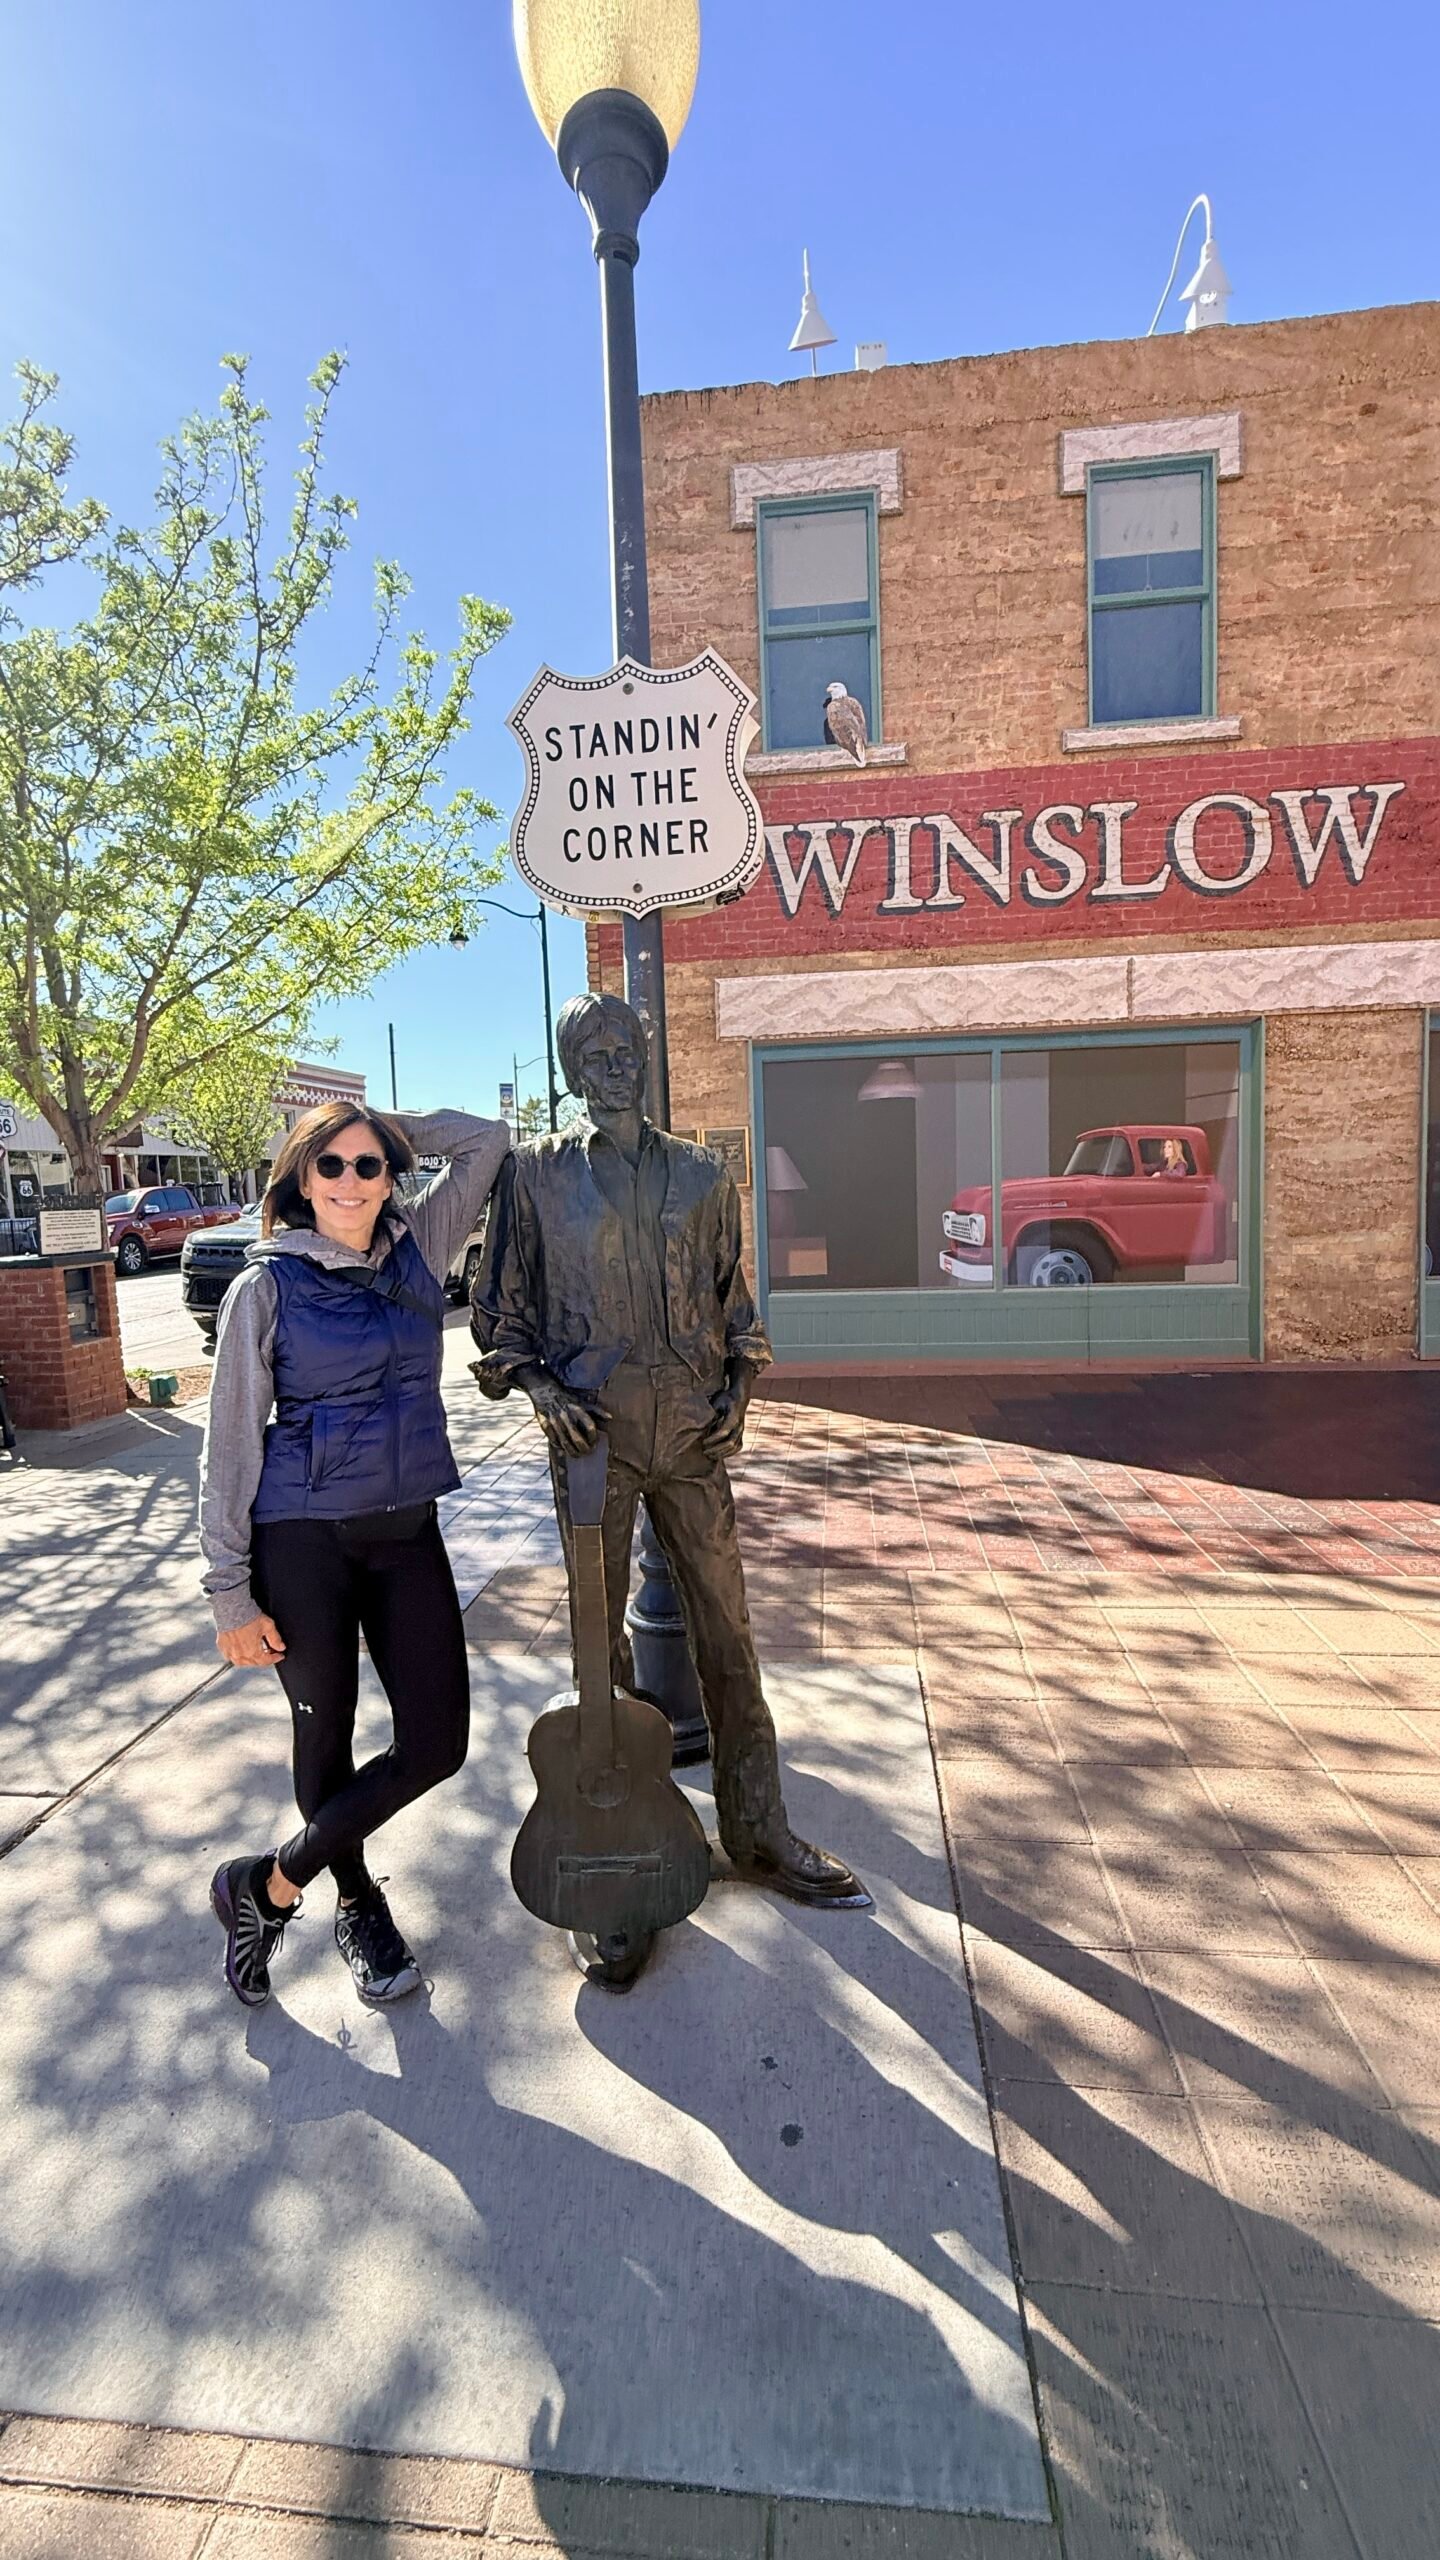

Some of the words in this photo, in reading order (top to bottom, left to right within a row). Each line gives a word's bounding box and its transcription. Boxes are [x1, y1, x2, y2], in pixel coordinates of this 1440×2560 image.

[545, 712, 718, 762] STANDIN'
[569, 774, 615, 812] ON
[631, 767, 698, 806] THE
[563, 819, 709, 862] CORNER
[763, 782, 1405, 918] WINSLOW
[419, 1156, 447, 1166] BOJO'S
